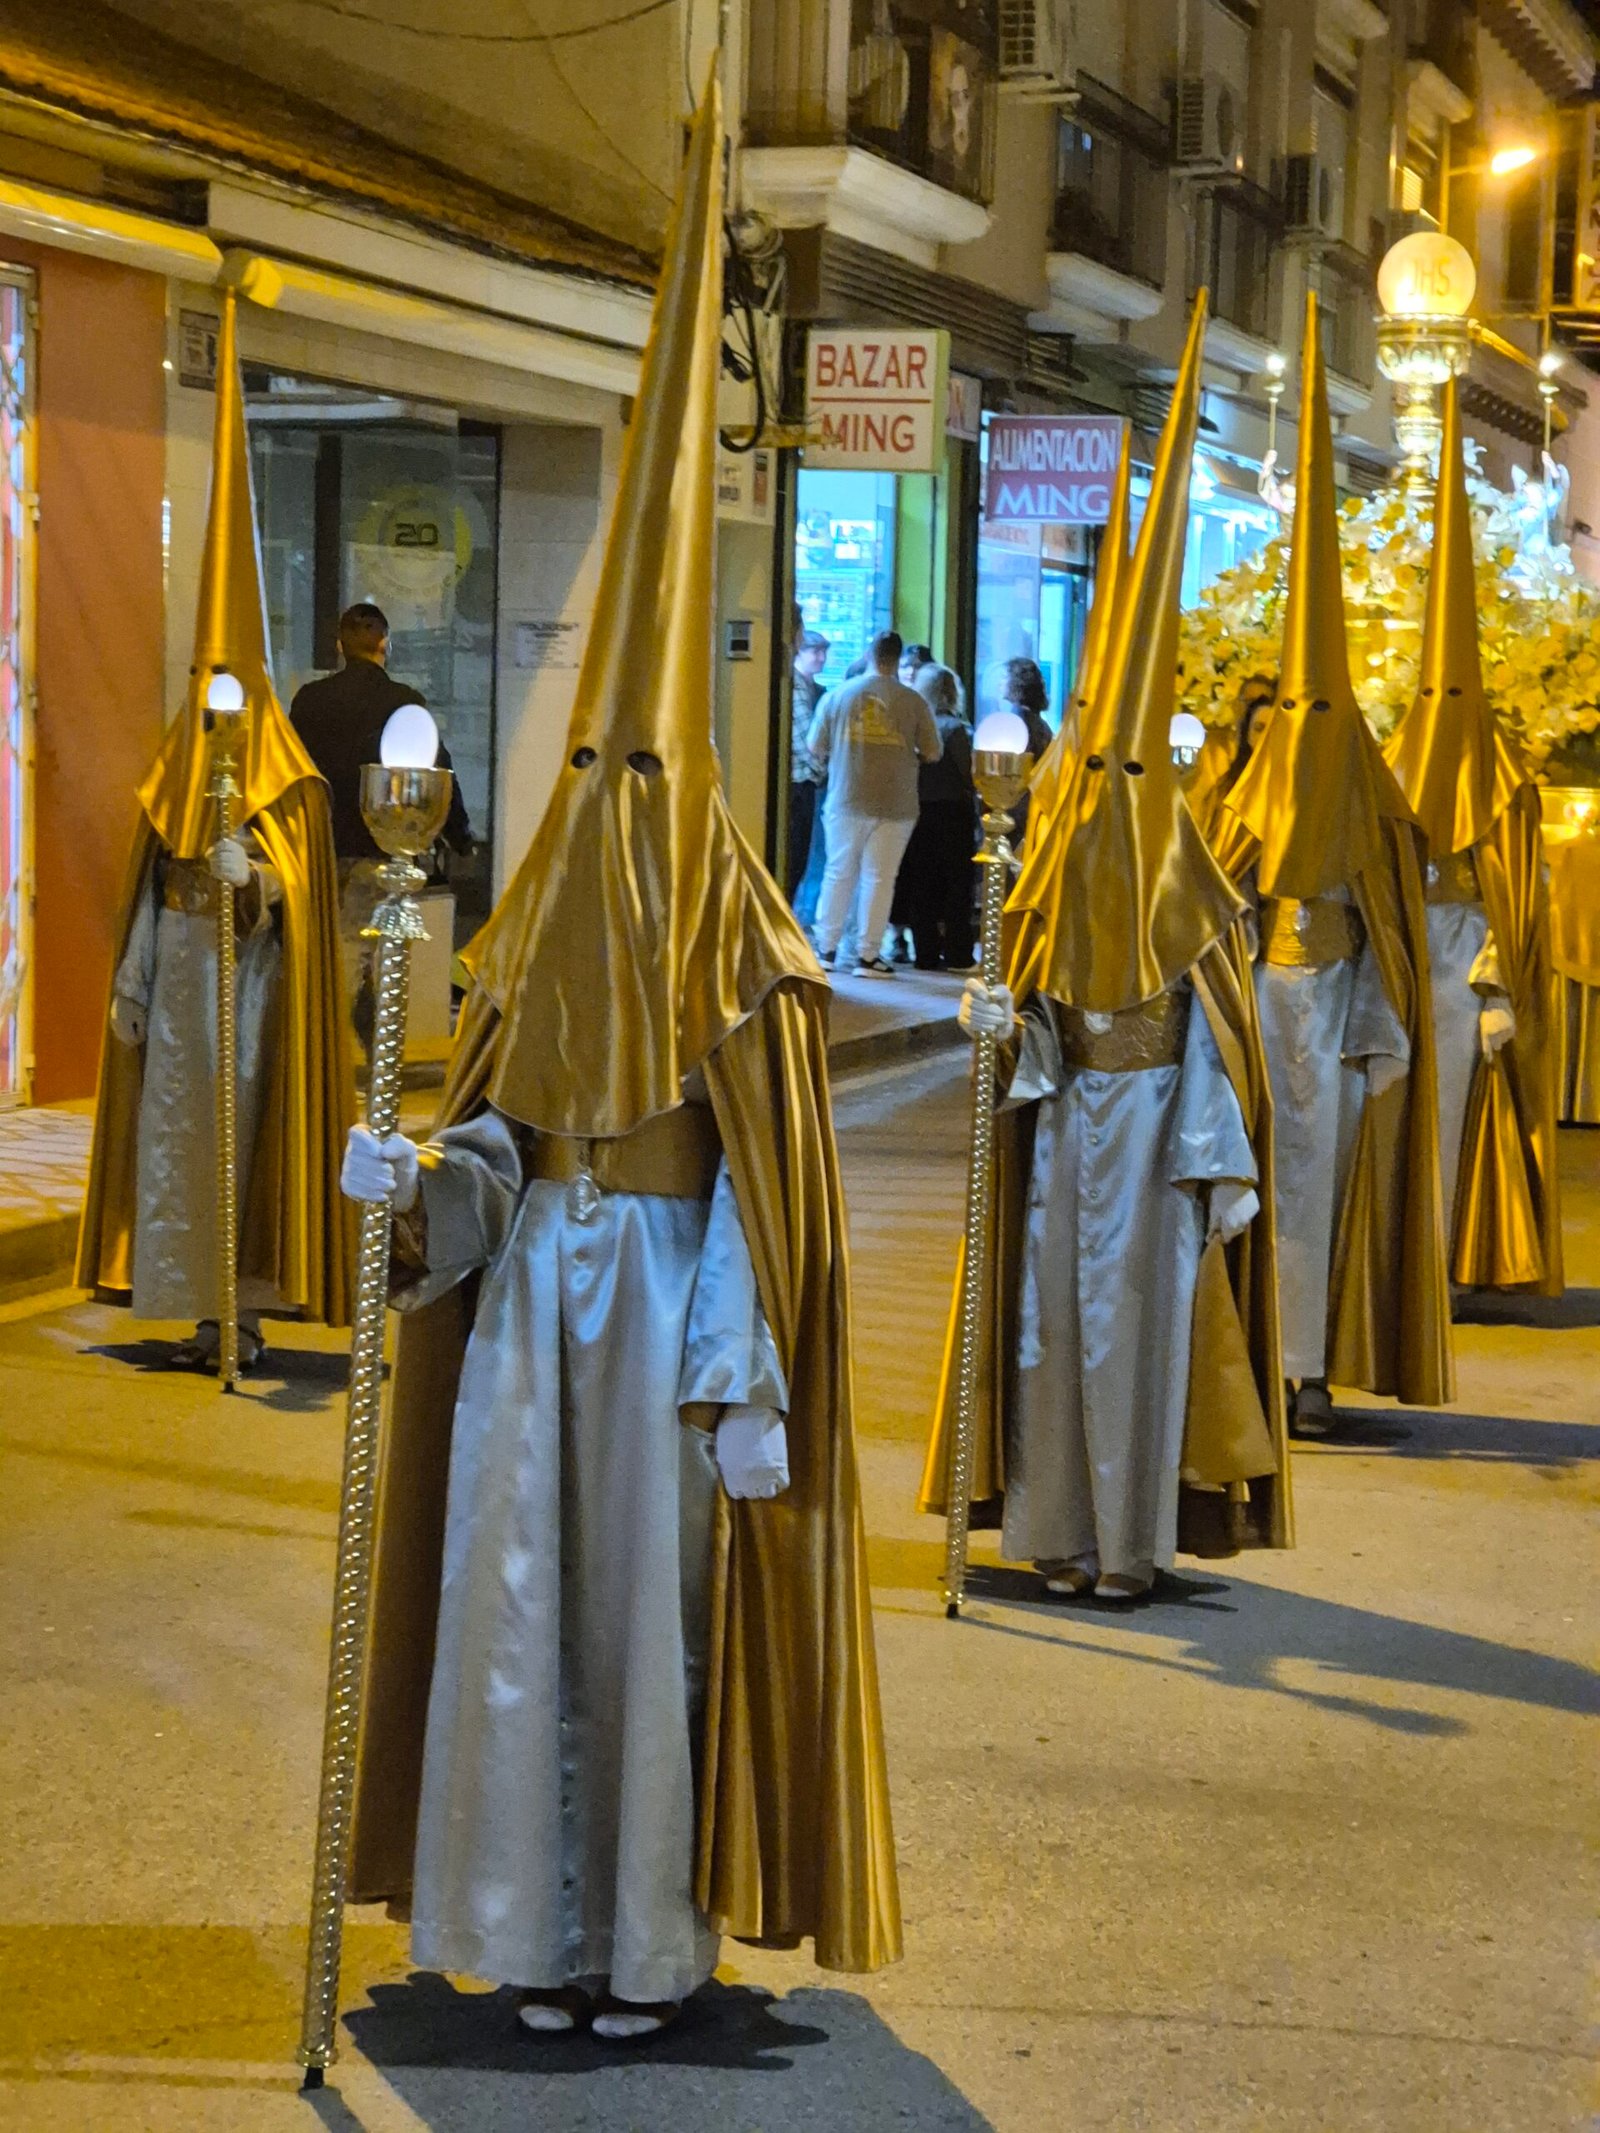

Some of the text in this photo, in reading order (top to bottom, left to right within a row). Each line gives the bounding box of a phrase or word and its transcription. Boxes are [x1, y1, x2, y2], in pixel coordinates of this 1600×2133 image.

[816, 344, 928, 388] BAZAR
[821, 413, 916, 453] MING
[990, 428, 1117, 472] ALIMENTACION
[994, 482, 1111, 518] MING
